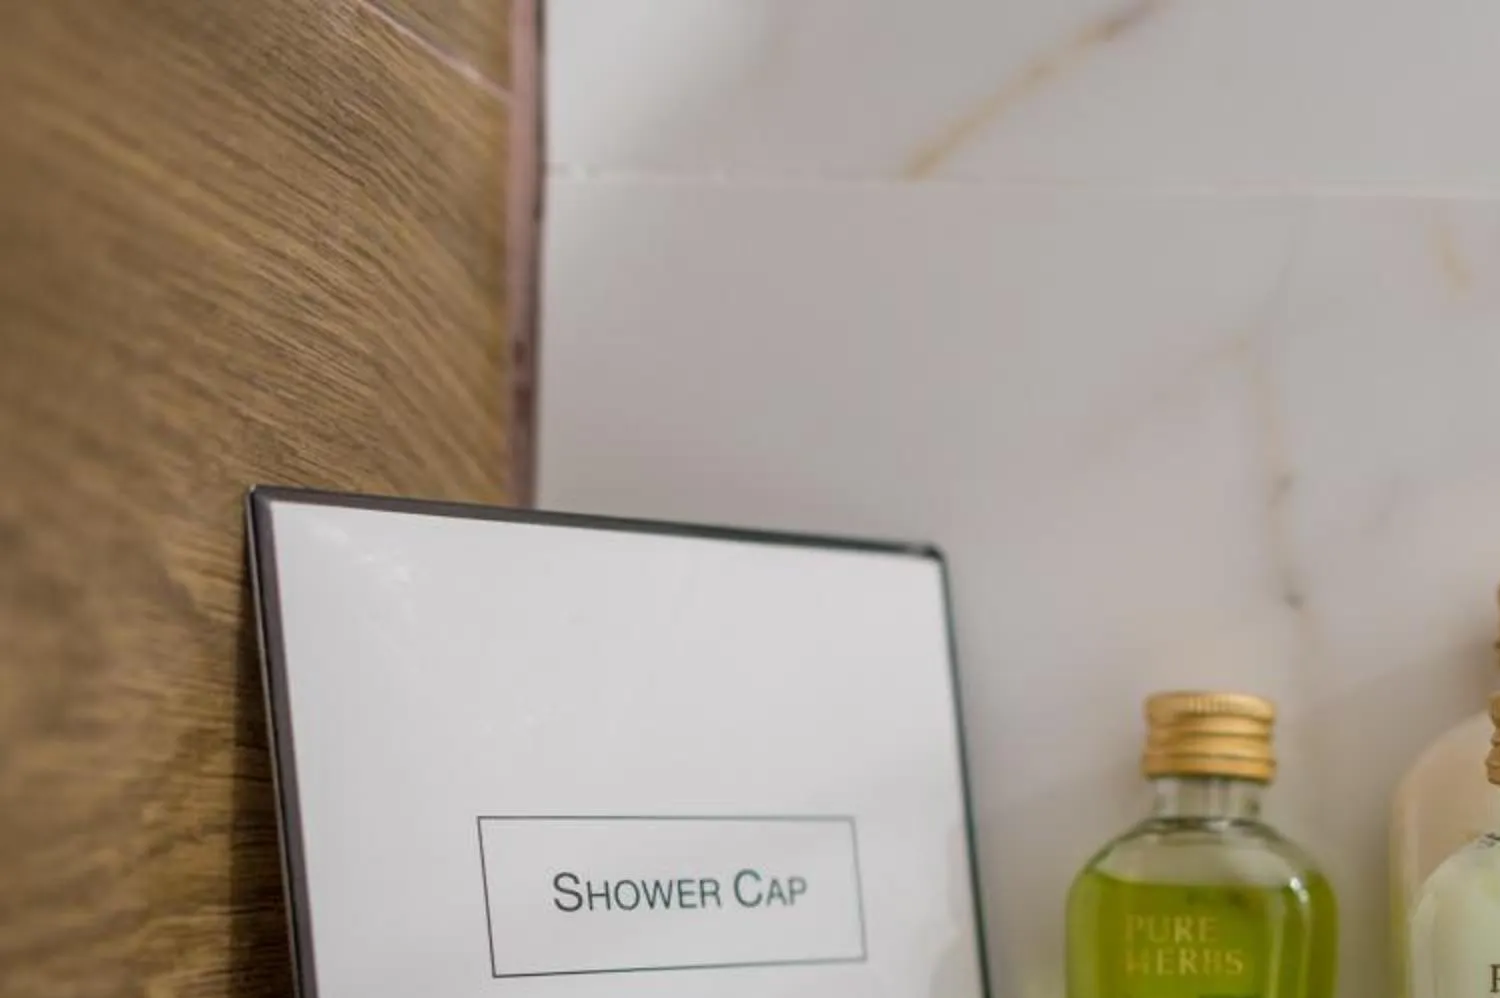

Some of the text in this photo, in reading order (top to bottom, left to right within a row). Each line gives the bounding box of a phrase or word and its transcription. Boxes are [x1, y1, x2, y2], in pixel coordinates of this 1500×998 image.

[552, 868, 808, 912] SHOWER CAP
[1125, 914, 1218, 944] PURE
[1125, 947, 1244, 977] HERBS
